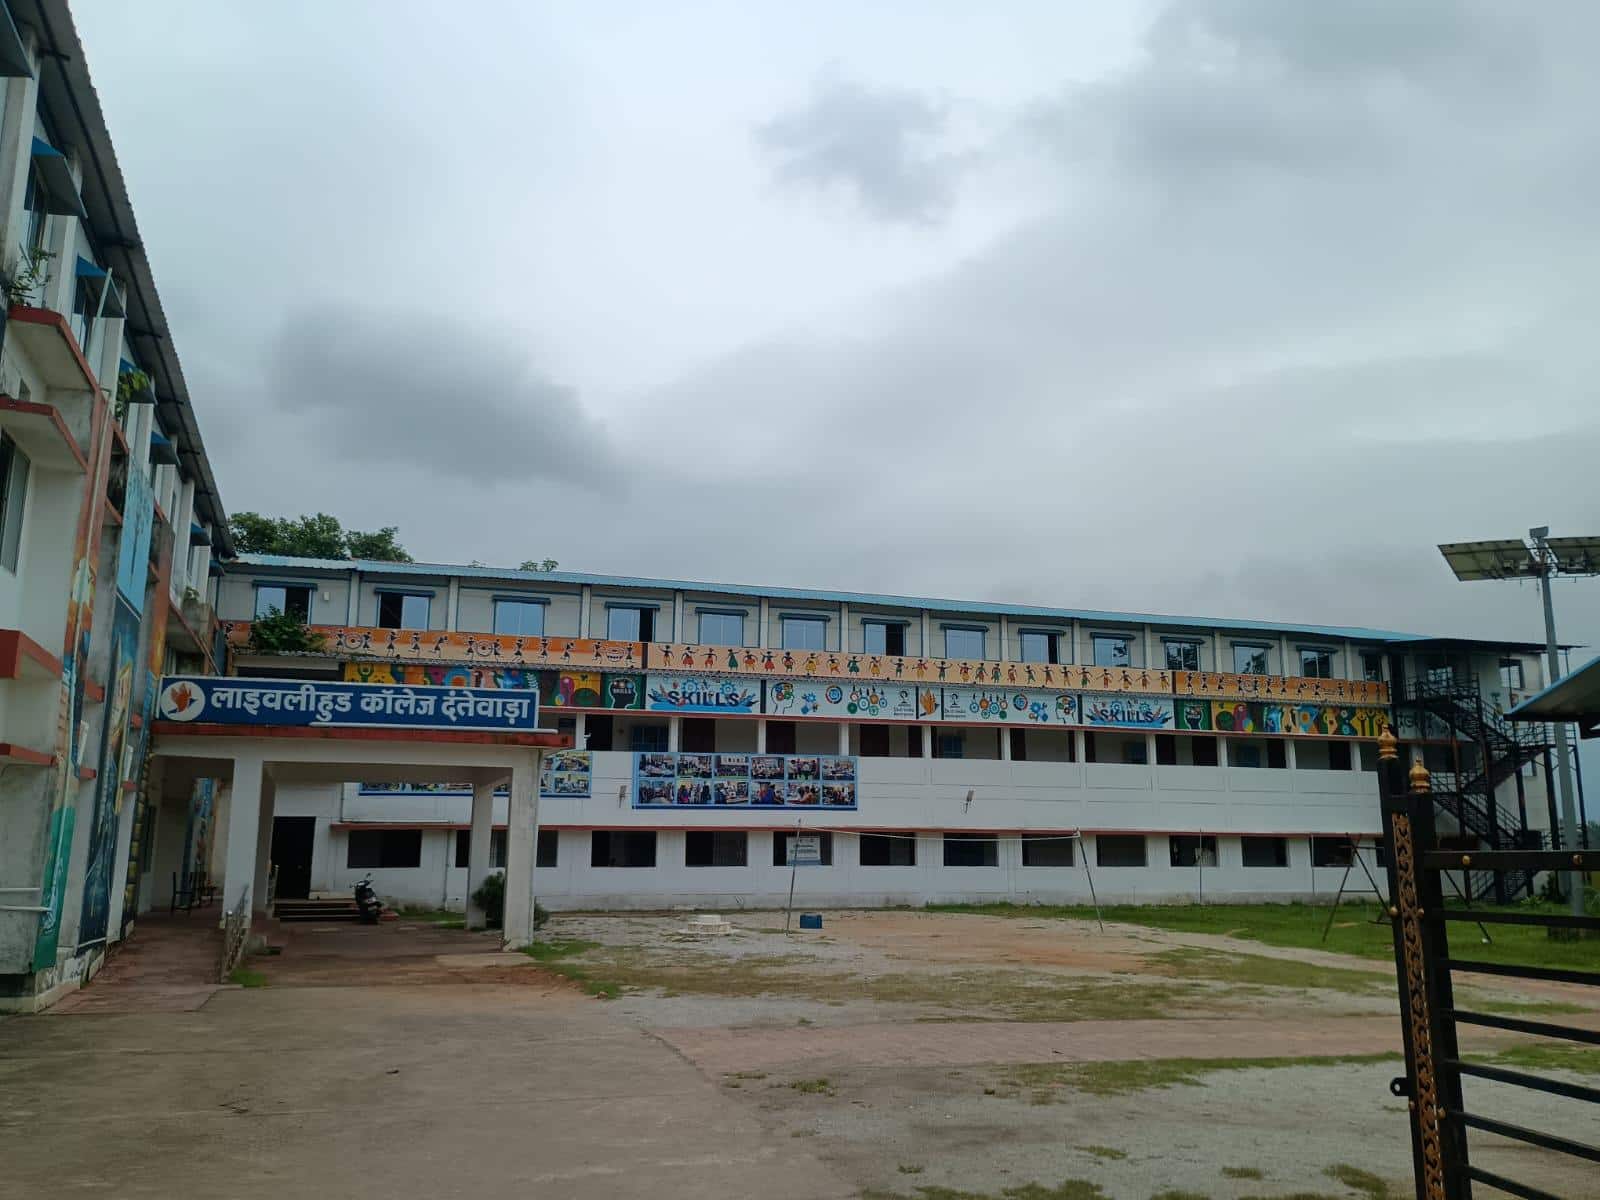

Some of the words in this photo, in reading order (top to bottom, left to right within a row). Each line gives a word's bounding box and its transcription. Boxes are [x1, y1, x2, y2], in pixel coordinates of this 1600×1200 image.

[210, 684, 353, 722] लाइवलीहुड
[360, 688, 437, 716] कॉलेज
[441, 691, 530, 725] दंतेवाड़ा
[667, 690, 740, 707] SKILLS
[1100, 709, 1154, 723] SKILLS
